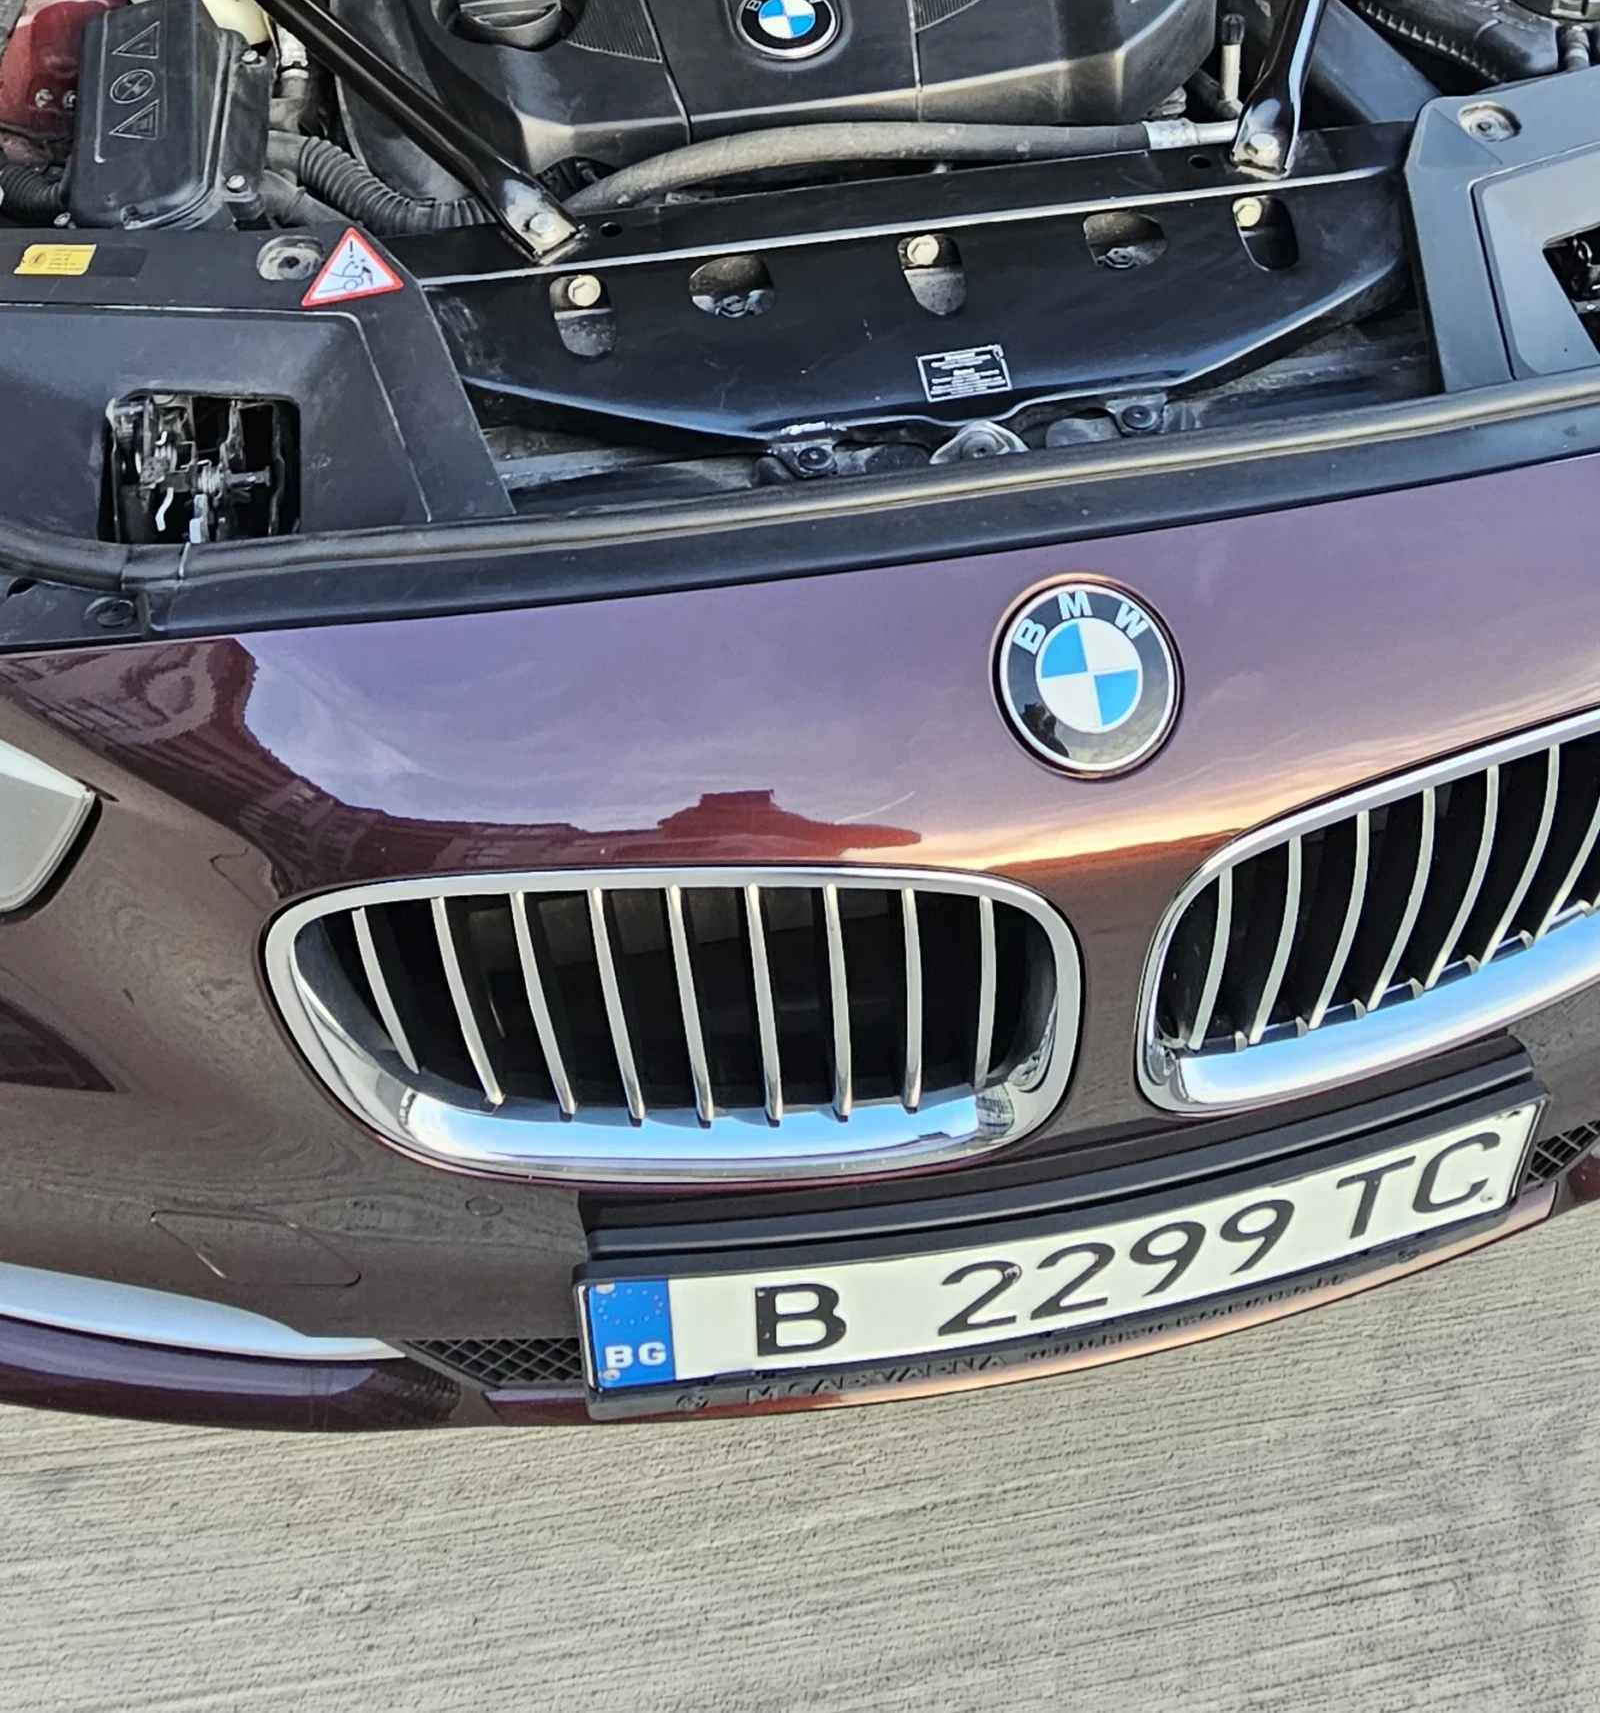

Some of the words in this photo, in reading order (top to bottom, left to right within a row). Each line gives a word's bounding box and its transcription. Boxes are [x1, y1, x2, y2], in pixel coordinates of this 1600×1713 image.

[1013, 590, 1149, 654] BMW
[755, 1283, 847, 1356] B
[938, 1199, 1295, 1336] 2299
[1336, 1131, 1501, 1240] TC
[605, 1342, 667, 1369] BG
